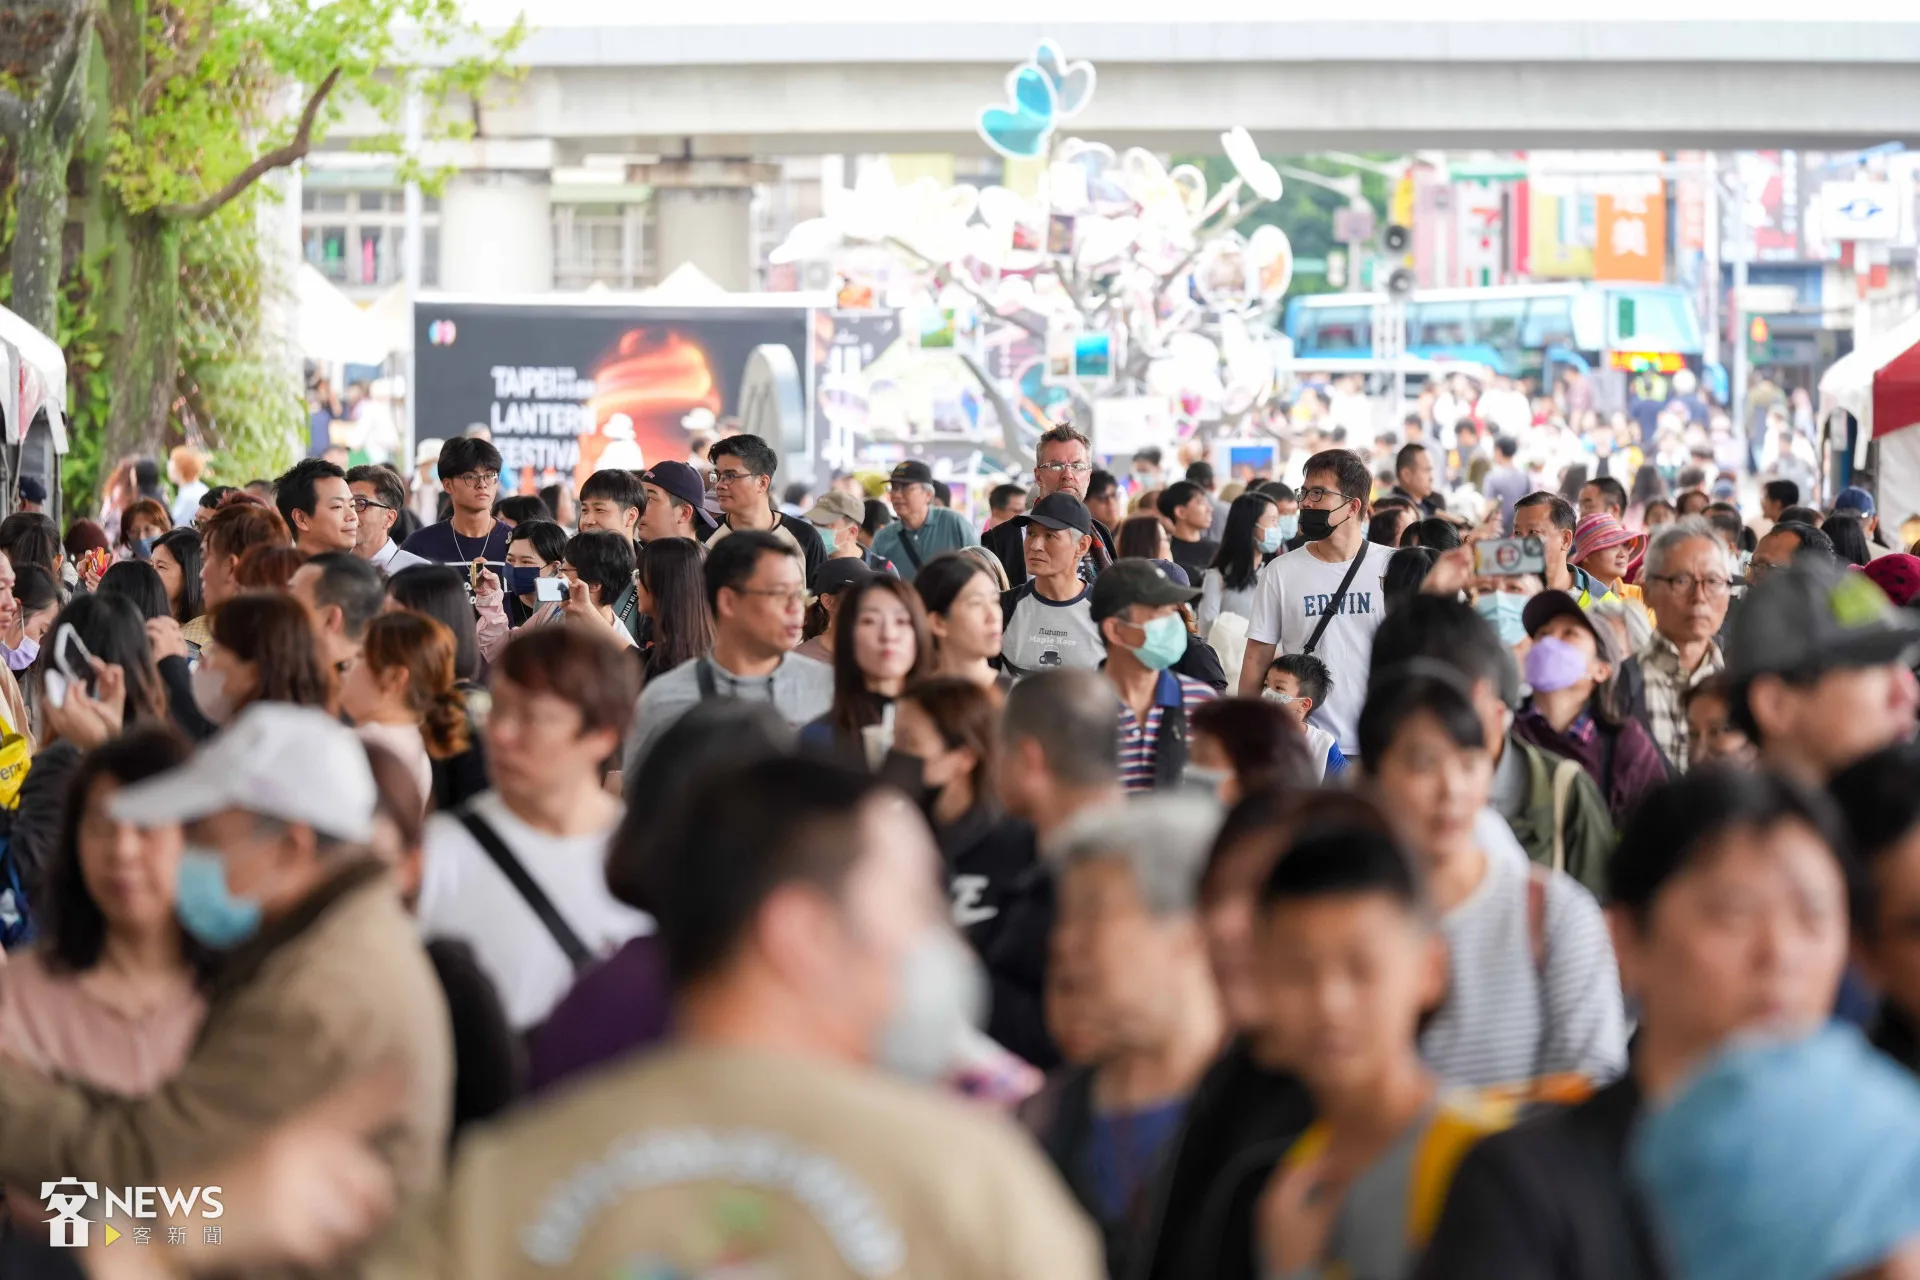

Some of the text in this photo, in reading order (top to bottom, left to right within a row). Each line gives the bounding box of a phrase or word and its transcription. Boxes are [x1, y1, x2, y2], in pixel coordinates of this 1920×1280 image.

[491, 366, 557, 399] TAIPEI
[491, 401, 597, 435] LANTERN
[493, 437, 581, 471] FESTIVA
